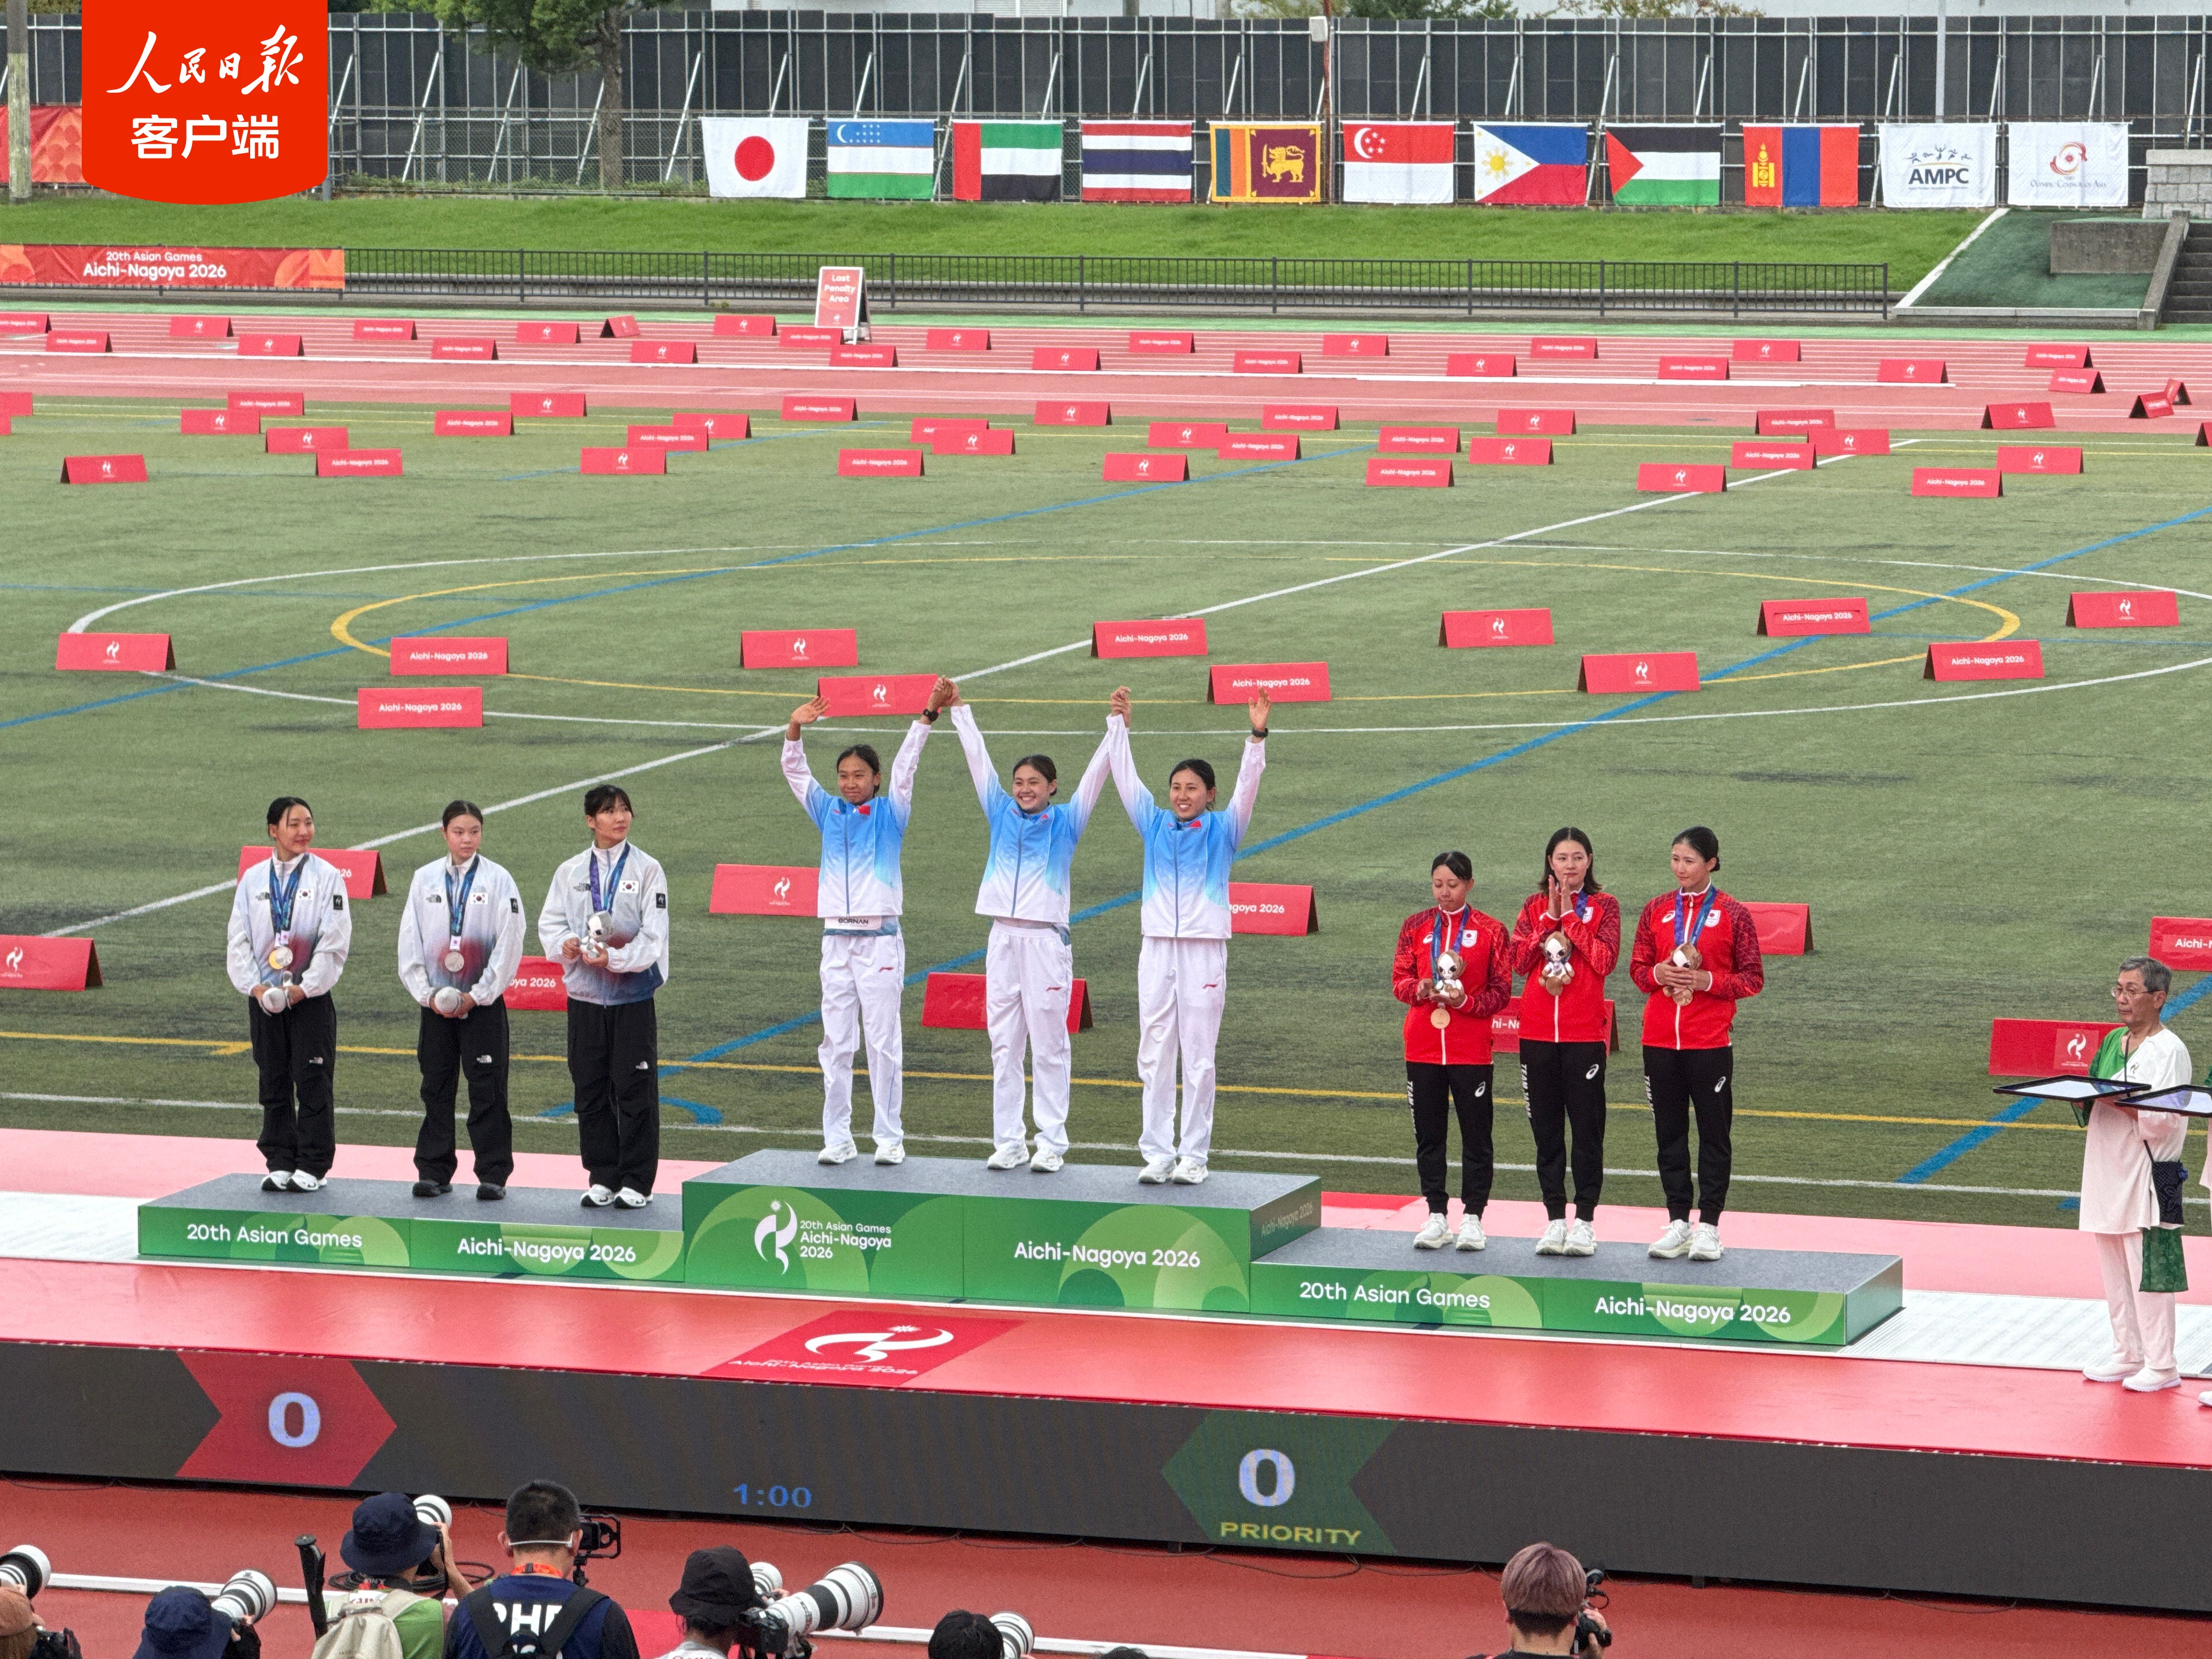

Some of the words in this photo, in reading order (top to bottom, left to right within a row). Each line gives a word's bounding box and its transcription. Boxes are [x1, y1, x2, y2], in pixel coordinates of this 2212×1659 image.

[1908, 168, 1969, 184] AMPC
[106, 252, 130, 261] 20th
[134, 251, 161, 261] Asian
[165, 252, 202, 261] Games
[83, 263, 185, 280] Aichi-Nagoya
[189, 264, 227, 278] 2026
[824, 284, 856, 295] Penalty
[410, 652, 465, 661] Aichi-Nagoya
[1952, 657, 2004, 665] Aichi-Nagoya
[1233, 680, 1288, 688] Aichi-Nagoya
[379, 704, 438, 713] Aichi-Nagoya
[1259, 904, 1285, 913] 2026
[529, 977, 556, 988] 2026
[800, 1220, 823, 1230] 20th
[826, 1221, 853, 1232] Asian
[856, 1223, 891, 1234] Games
[188, 1224, 230, 1240] 20th
[237, 1226, 287, 1243] Asian
[295, 1229, 362, 1248] Games
[800, 1231, 891, 1251] Aichi-Nagoya
[458, 1238, 584, 1263] Aichi-Nagoya
[590, 1245, 636, 1262] 2026
[800, 1246, 833, 1259] 2026
[1014, 1241, 1146, 1268] Aichi-Nagoya
[1153, 1250, 1200, 1267] 2026
[1300, 1282, 1346, 1300] 20th
[1354, 1284, 1409, 1303] Asian
[1417, 1289, 1490, 1308] Games
[1595, 1296, 1734, 1324] Aichi-Nagoya
[1740, 1305, 1791, 1323] 2026
[268, 1392, 321, 1448] 0
[1238, 1449, 1295, 1506] 0
[733, 1483, 812, 1508] 1:00
[1221, 1521, 1361, 1546] PRIORITY
